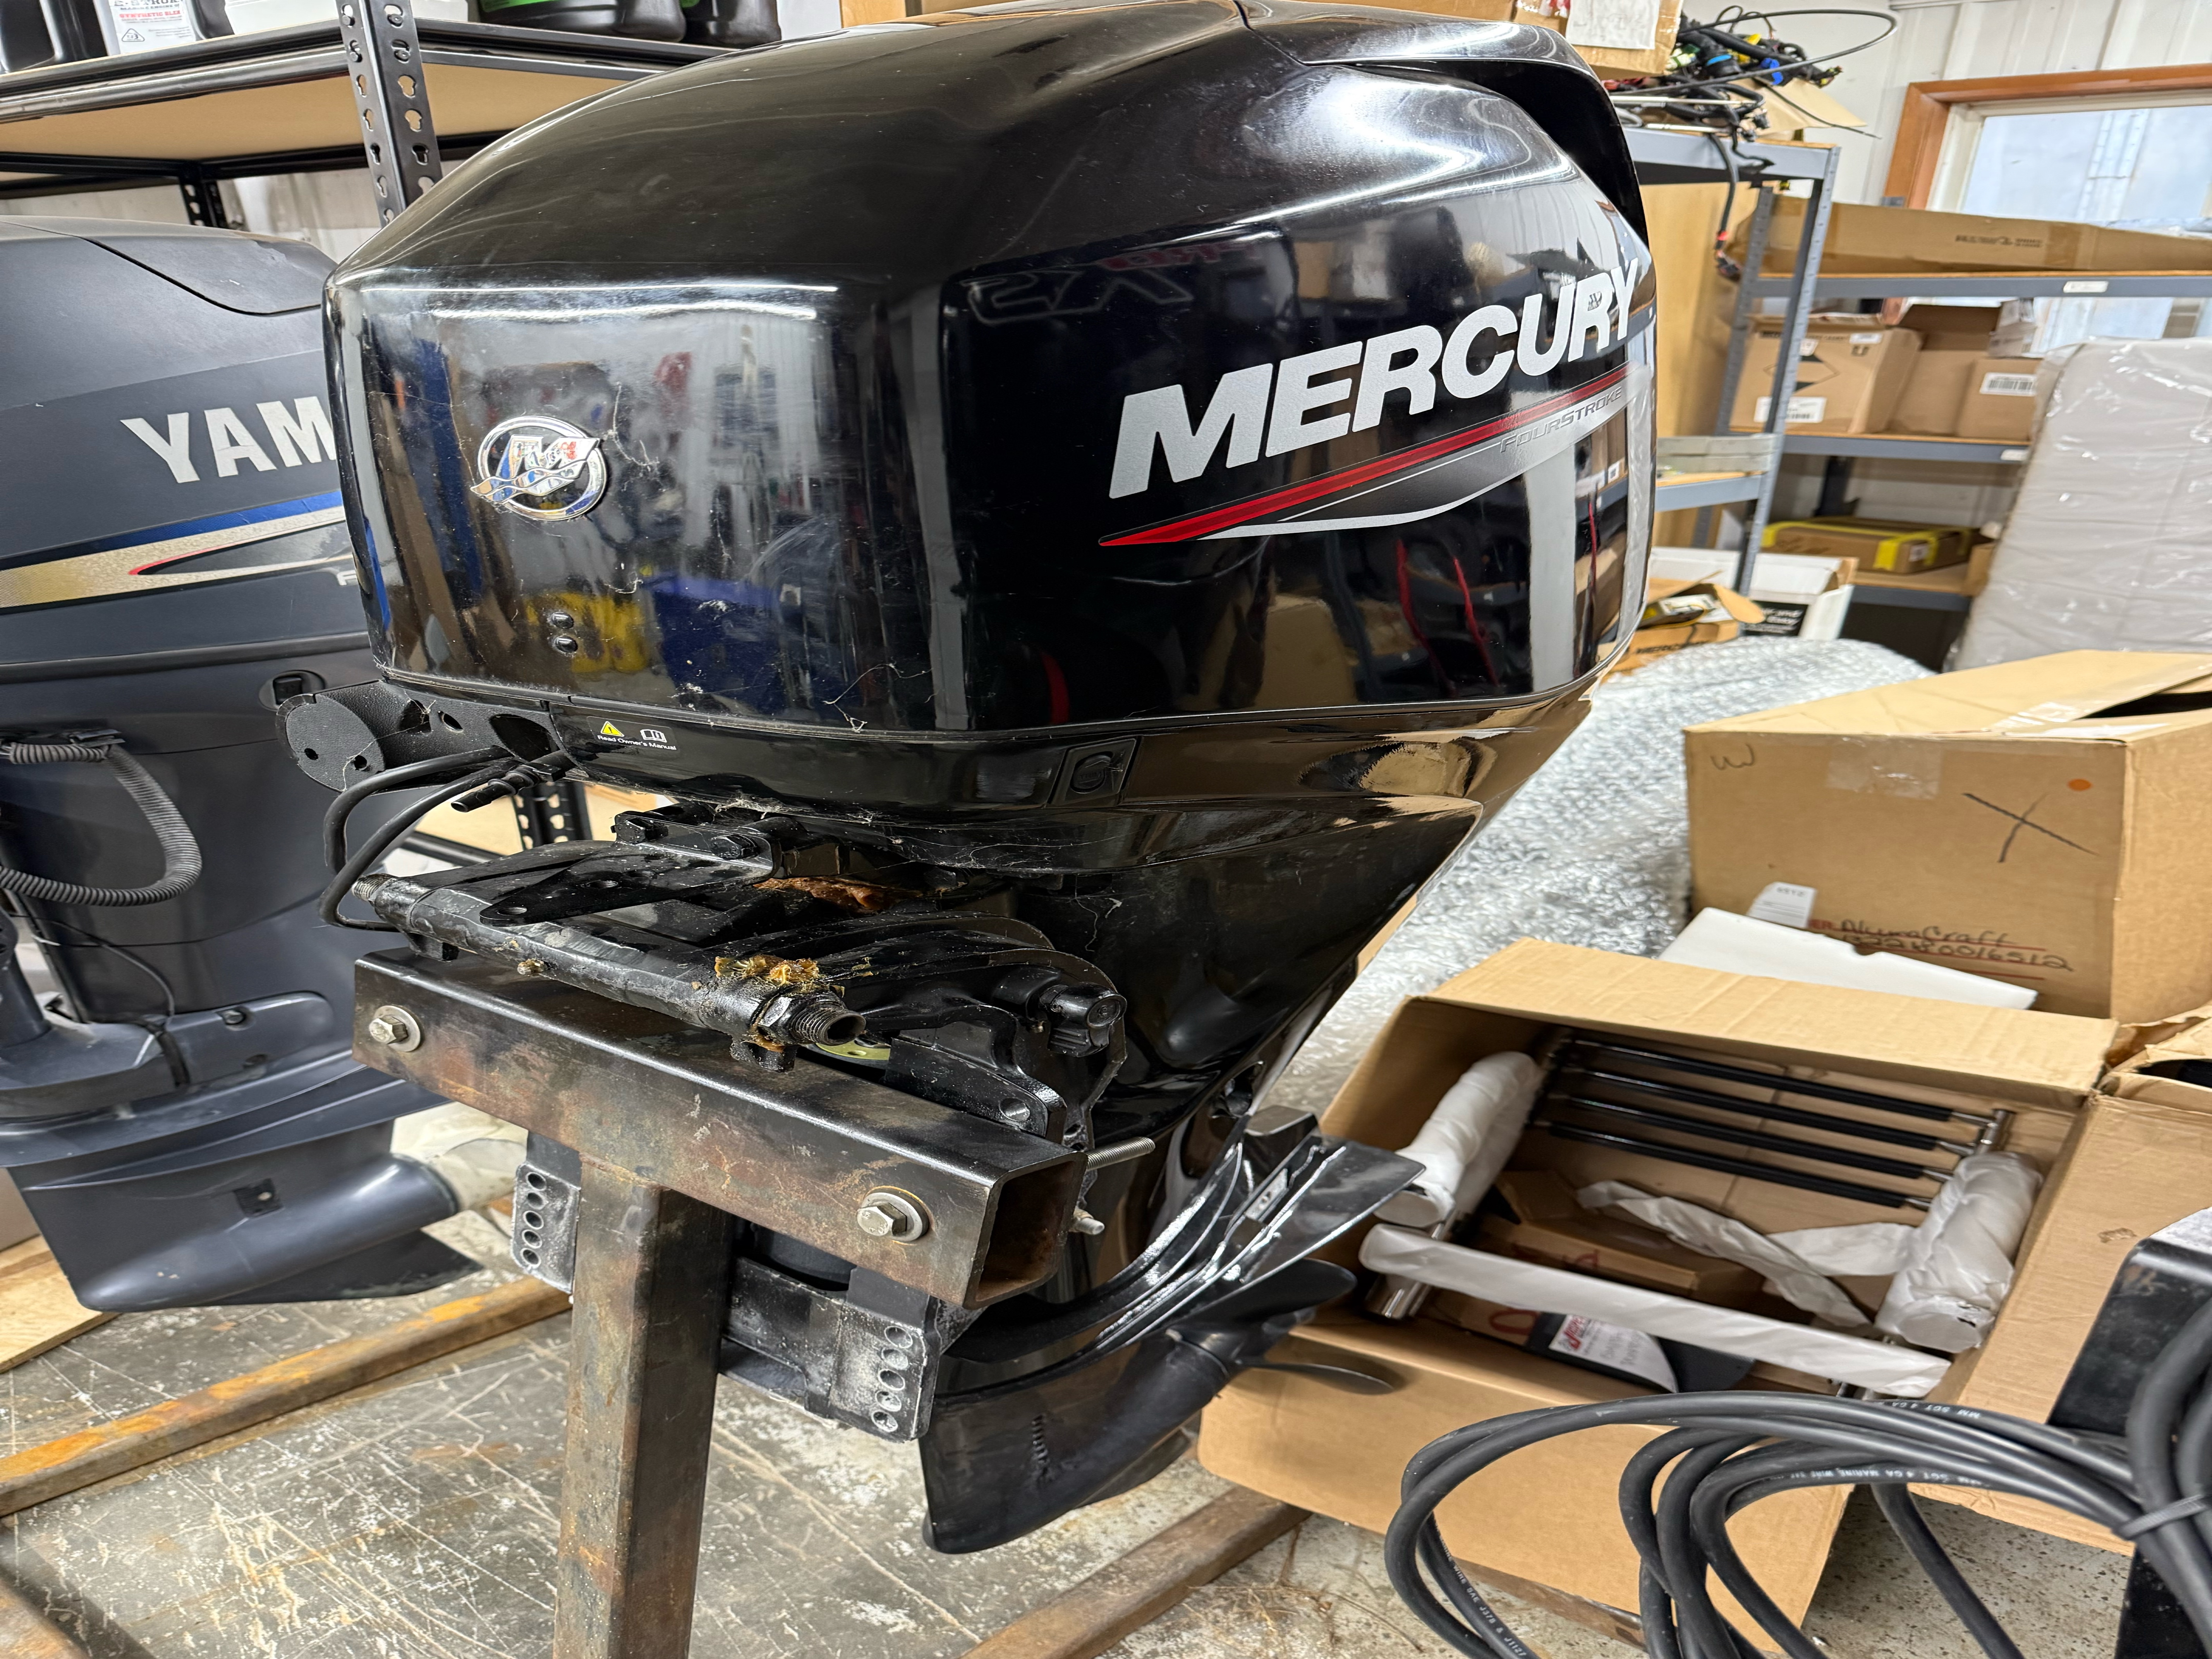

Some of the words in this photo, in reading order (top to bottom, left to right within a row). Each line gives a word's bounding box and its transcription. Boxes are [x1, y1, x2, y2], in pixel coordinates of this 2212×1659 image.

[1109, 259, 1639, 499] MERCURY
[618, 738, 648, 747] Owner's
[649, 742, 677, 750] Manual
[1453, 1565, 1467, 1584] WIRE
[1467, 1587, 1480, 1603] SAE
[1504, 1636, 1527, 1657] J1127
